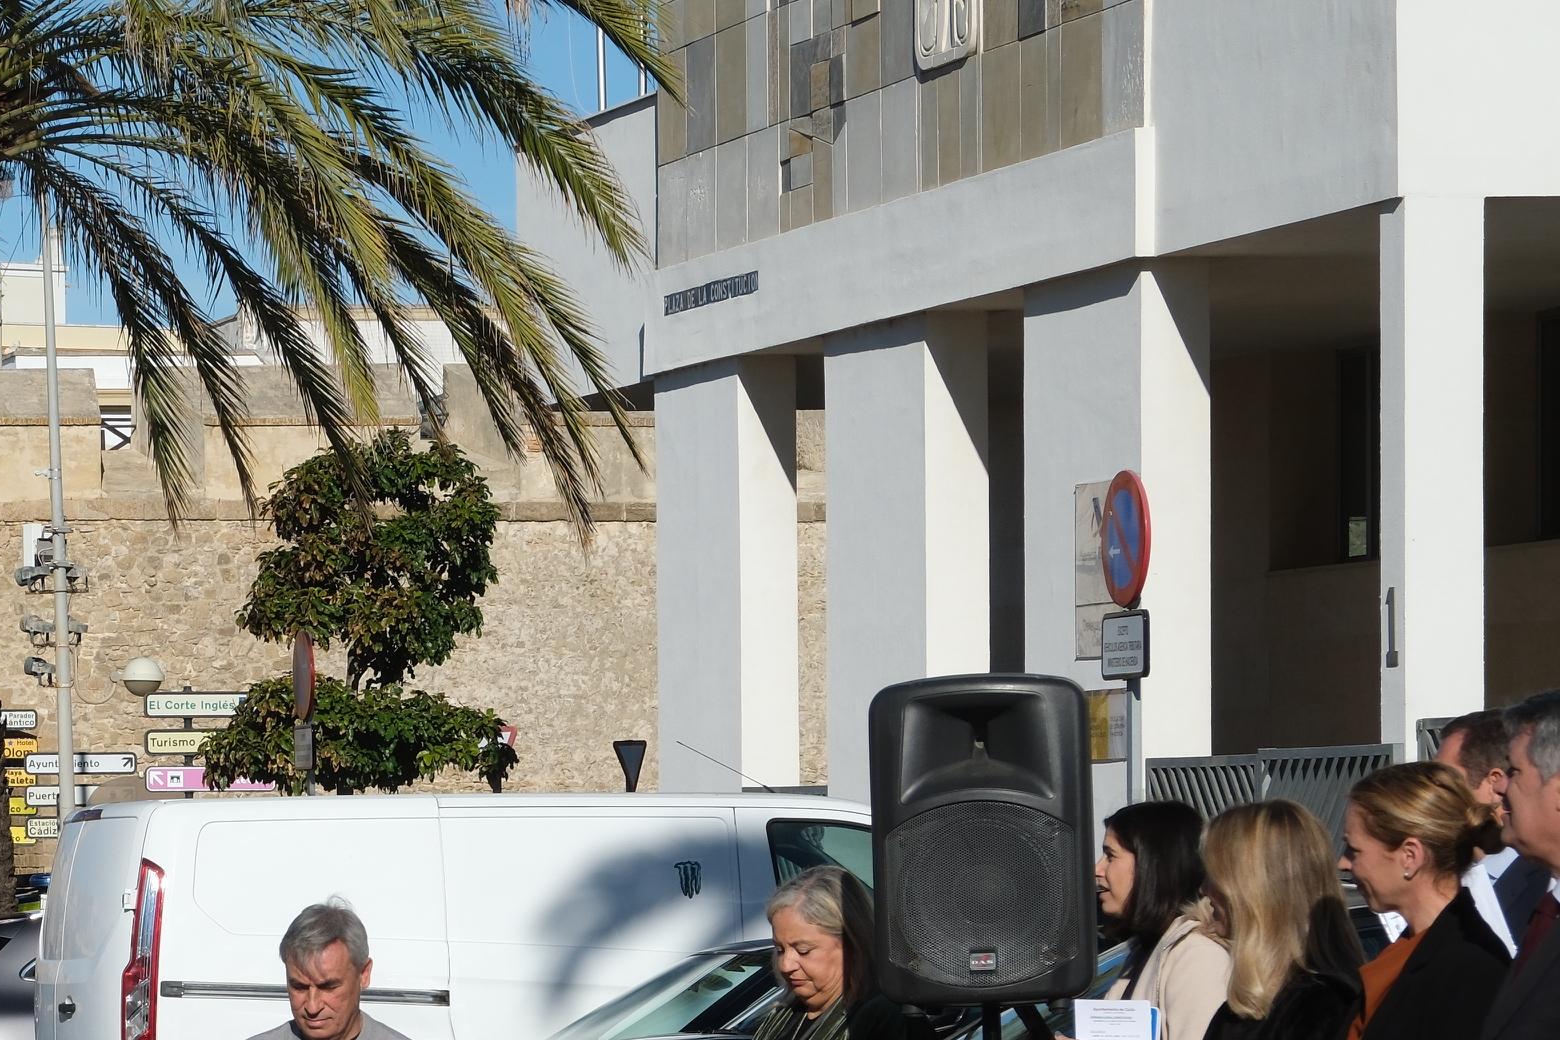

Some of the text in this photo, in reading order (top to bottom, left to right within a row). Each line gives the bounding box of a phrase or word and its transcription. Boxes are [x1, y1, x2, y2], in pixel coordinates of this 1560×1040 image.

[664, 295, 684, 314] PLAZA
[687, 290, 696, 309] DE
[698, 287, 708, 305] LA
[149, 701, 235, 712] El Corte Inglés
[150, 738, 196, 747] Turismo
[28, 759, 100, 769] Ayuntiento
[28, 792, 58, 800] Puert
[29, 819, 57, 827] Estació
[29, 826, 57, 836] Cádiz
